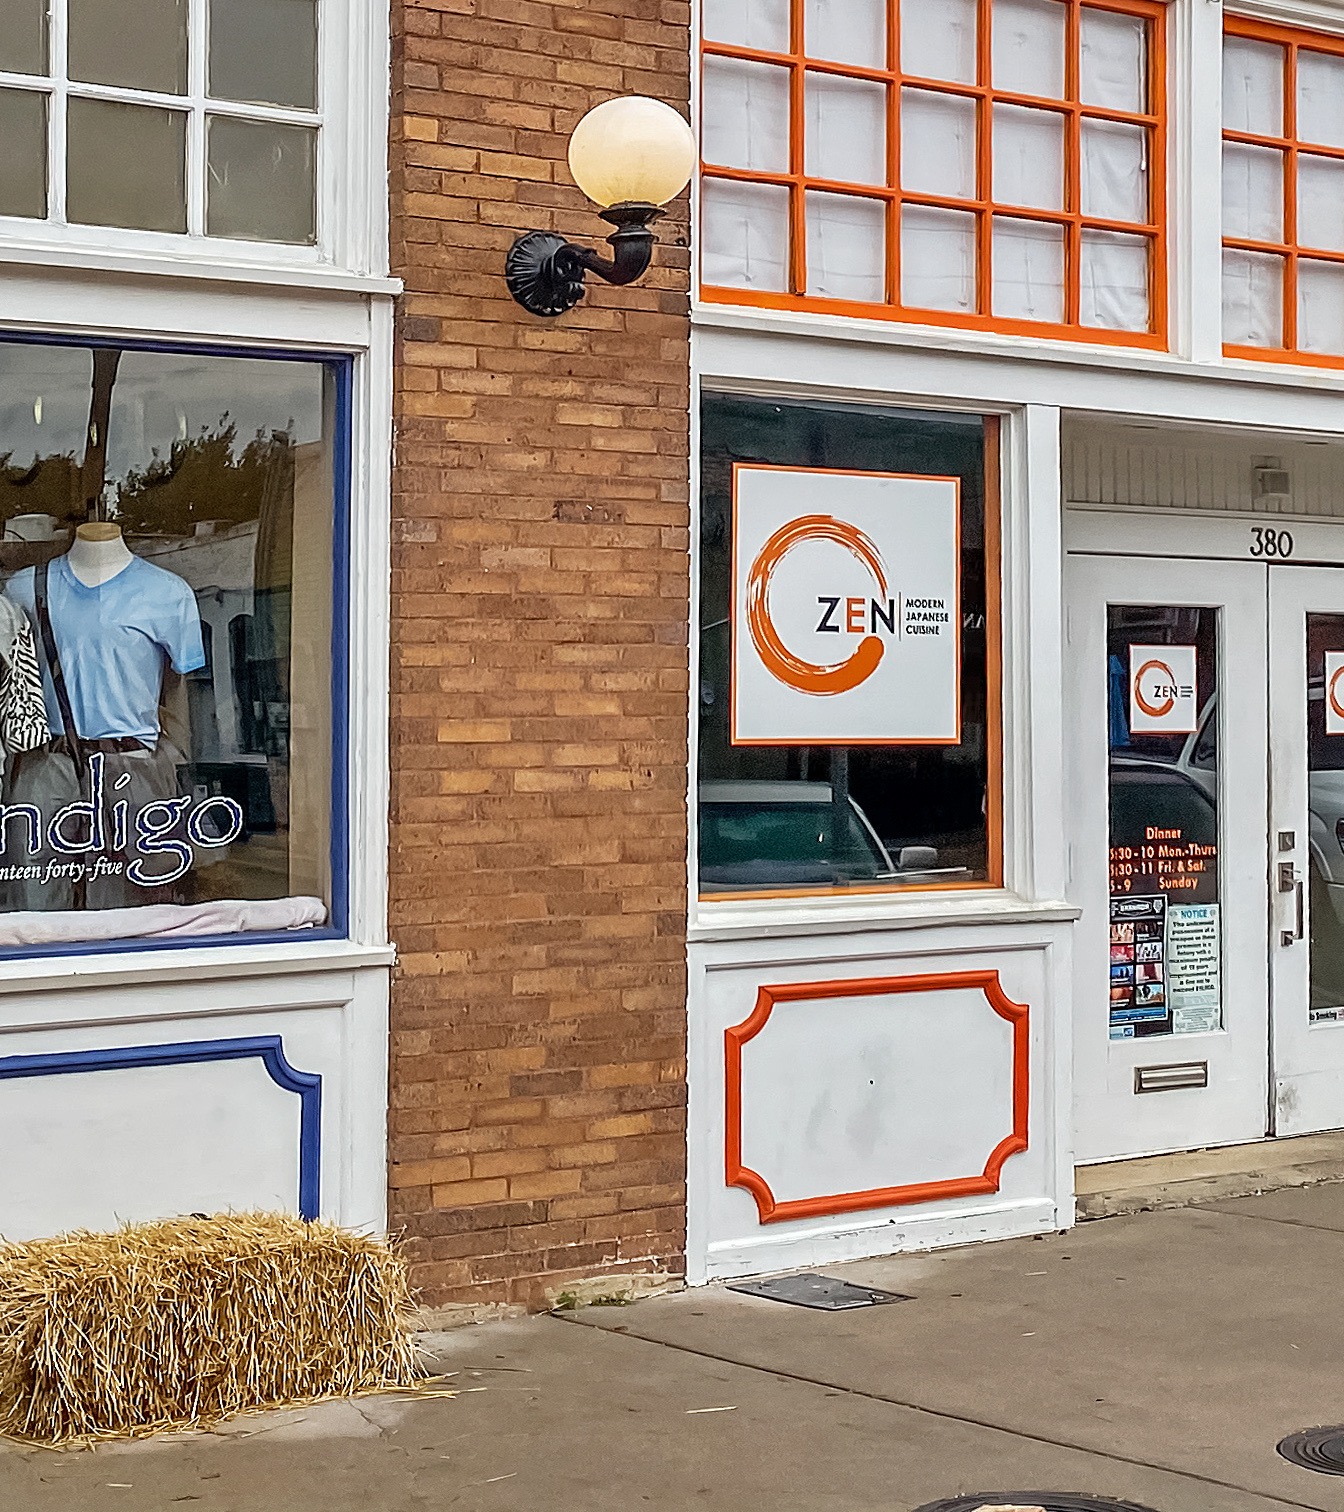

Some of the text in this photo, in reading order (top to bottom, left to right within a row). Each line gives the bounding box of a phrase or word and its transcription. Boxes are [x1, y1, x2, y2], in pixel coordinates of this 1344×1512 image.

[1249, 527, 1294, 558] 380
[905, 598, 945, 609] MODERN
[816, 596, 896, 635] ZEN
[905, 612, 949, 623] JAPANESE
[905, 625, 940, 636] CUISINE
[1153, 685, 1178, 698] ZEN
[1146, 826, 1181, 840] Dinner
[1141, 845, 1155, 858] 10
[40, 855, 124, 885] forty-five
[1141, 862, 1154, 875] 11
[1123, 878, 1132, 891] 9
[1159, 875, 1199, 890] Sunday
[1181, 909, 1208, 919] NOTICE
